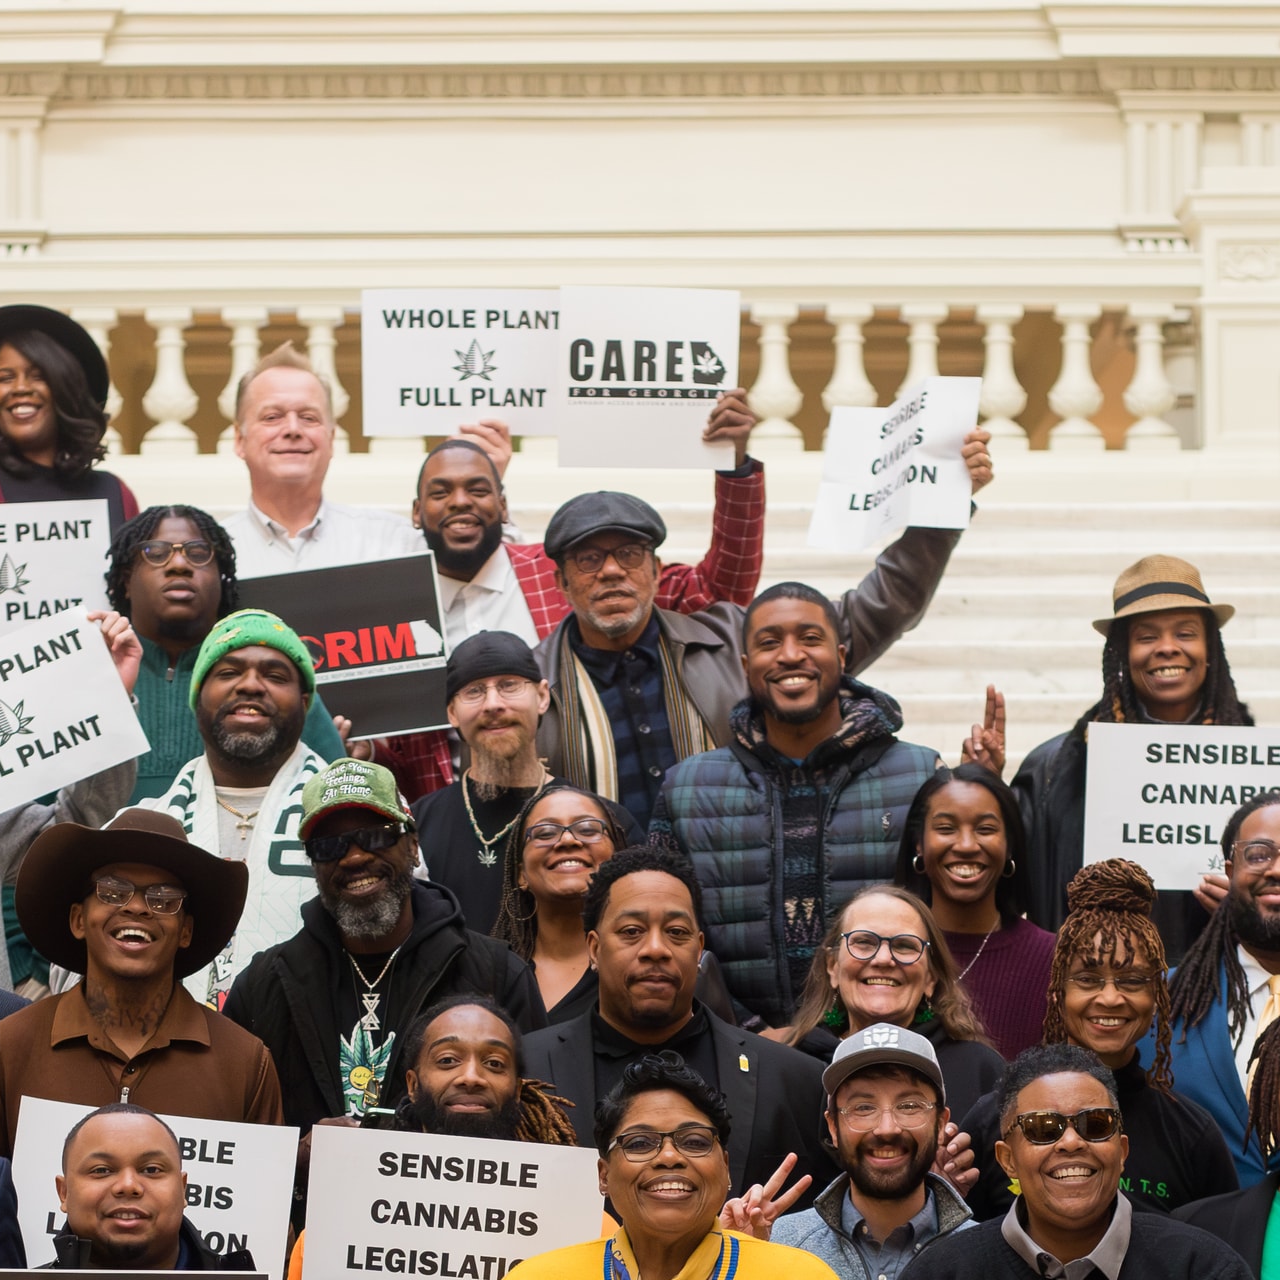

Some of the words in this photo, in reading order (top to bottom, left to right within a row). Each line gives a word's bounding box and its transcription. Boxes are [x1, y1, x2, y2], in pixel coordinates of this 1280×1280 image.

[382, 309, 477, 329] WHOLE
[486, 309, 560, 330] PLANT
[570, 338, 685, 382] CARE
[400, 387, 461, 407] FULL
[471, 387, 547, 407] PLANT
[572, 388, 611, 397] FOR
[16, 520, 92, 542] PLANT
[16, 714, 102, 768] PLANT
[325, 773, 366, 786] Feelings
[340, 784, 371, 797] Home
[1122, 823, 1223, 845] LEGISL
[377, 1151, 539, 1189] SENSIBLE
[370, 1199, 539, 1237] CANNABIS
